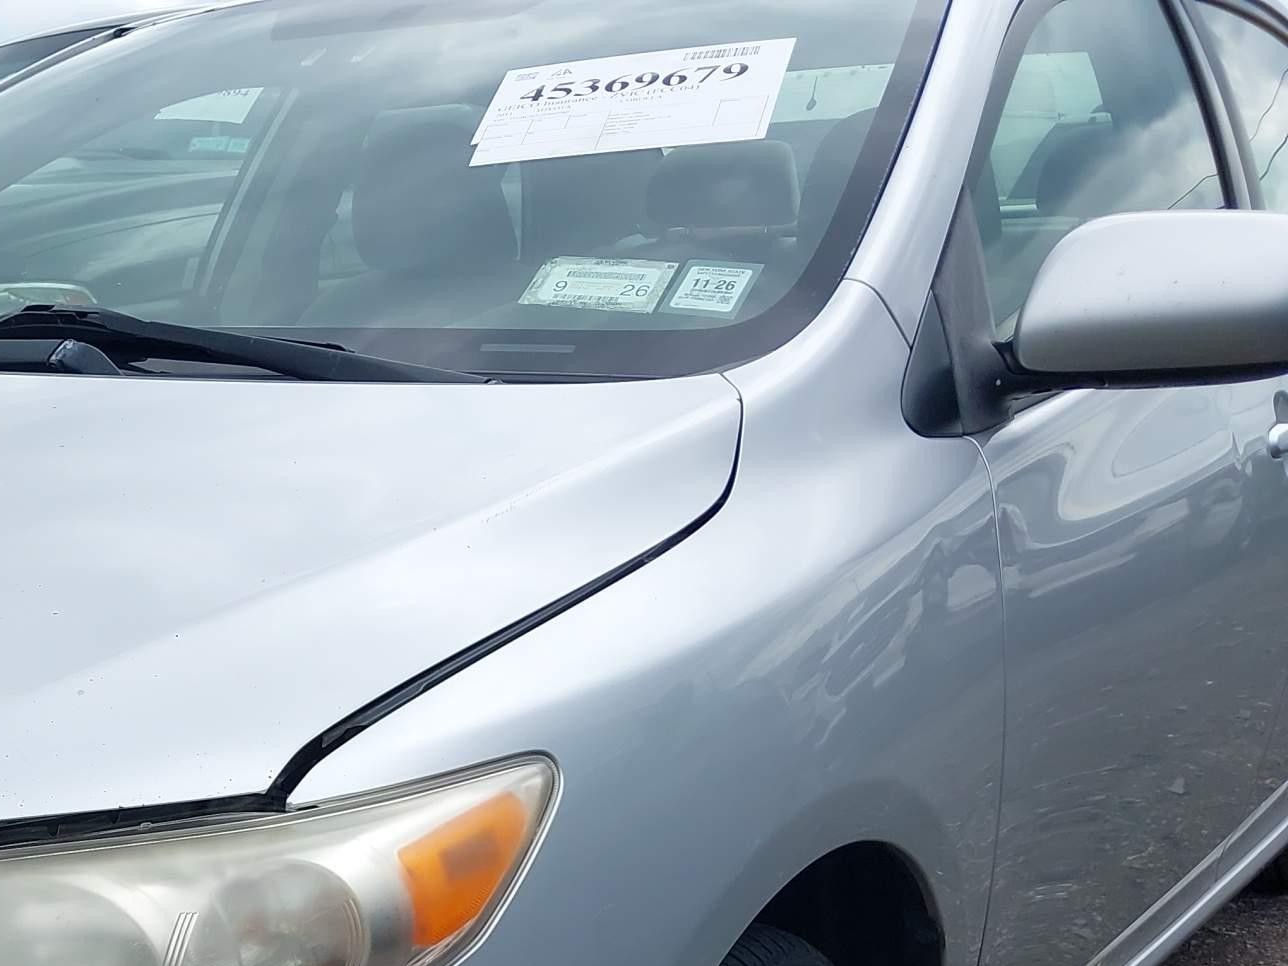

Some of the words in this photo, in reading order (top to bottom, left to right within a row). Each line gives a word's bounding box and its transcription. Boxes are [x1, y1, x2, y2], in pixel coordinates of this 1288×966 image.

[520, 63, 749, 101] 45369679
[497, 102, 539, 111] GEICO
[552, 280, 568, 292] 9
[620, 284, 650, 297] 26
[693, 278, 737, 291] 11-26
